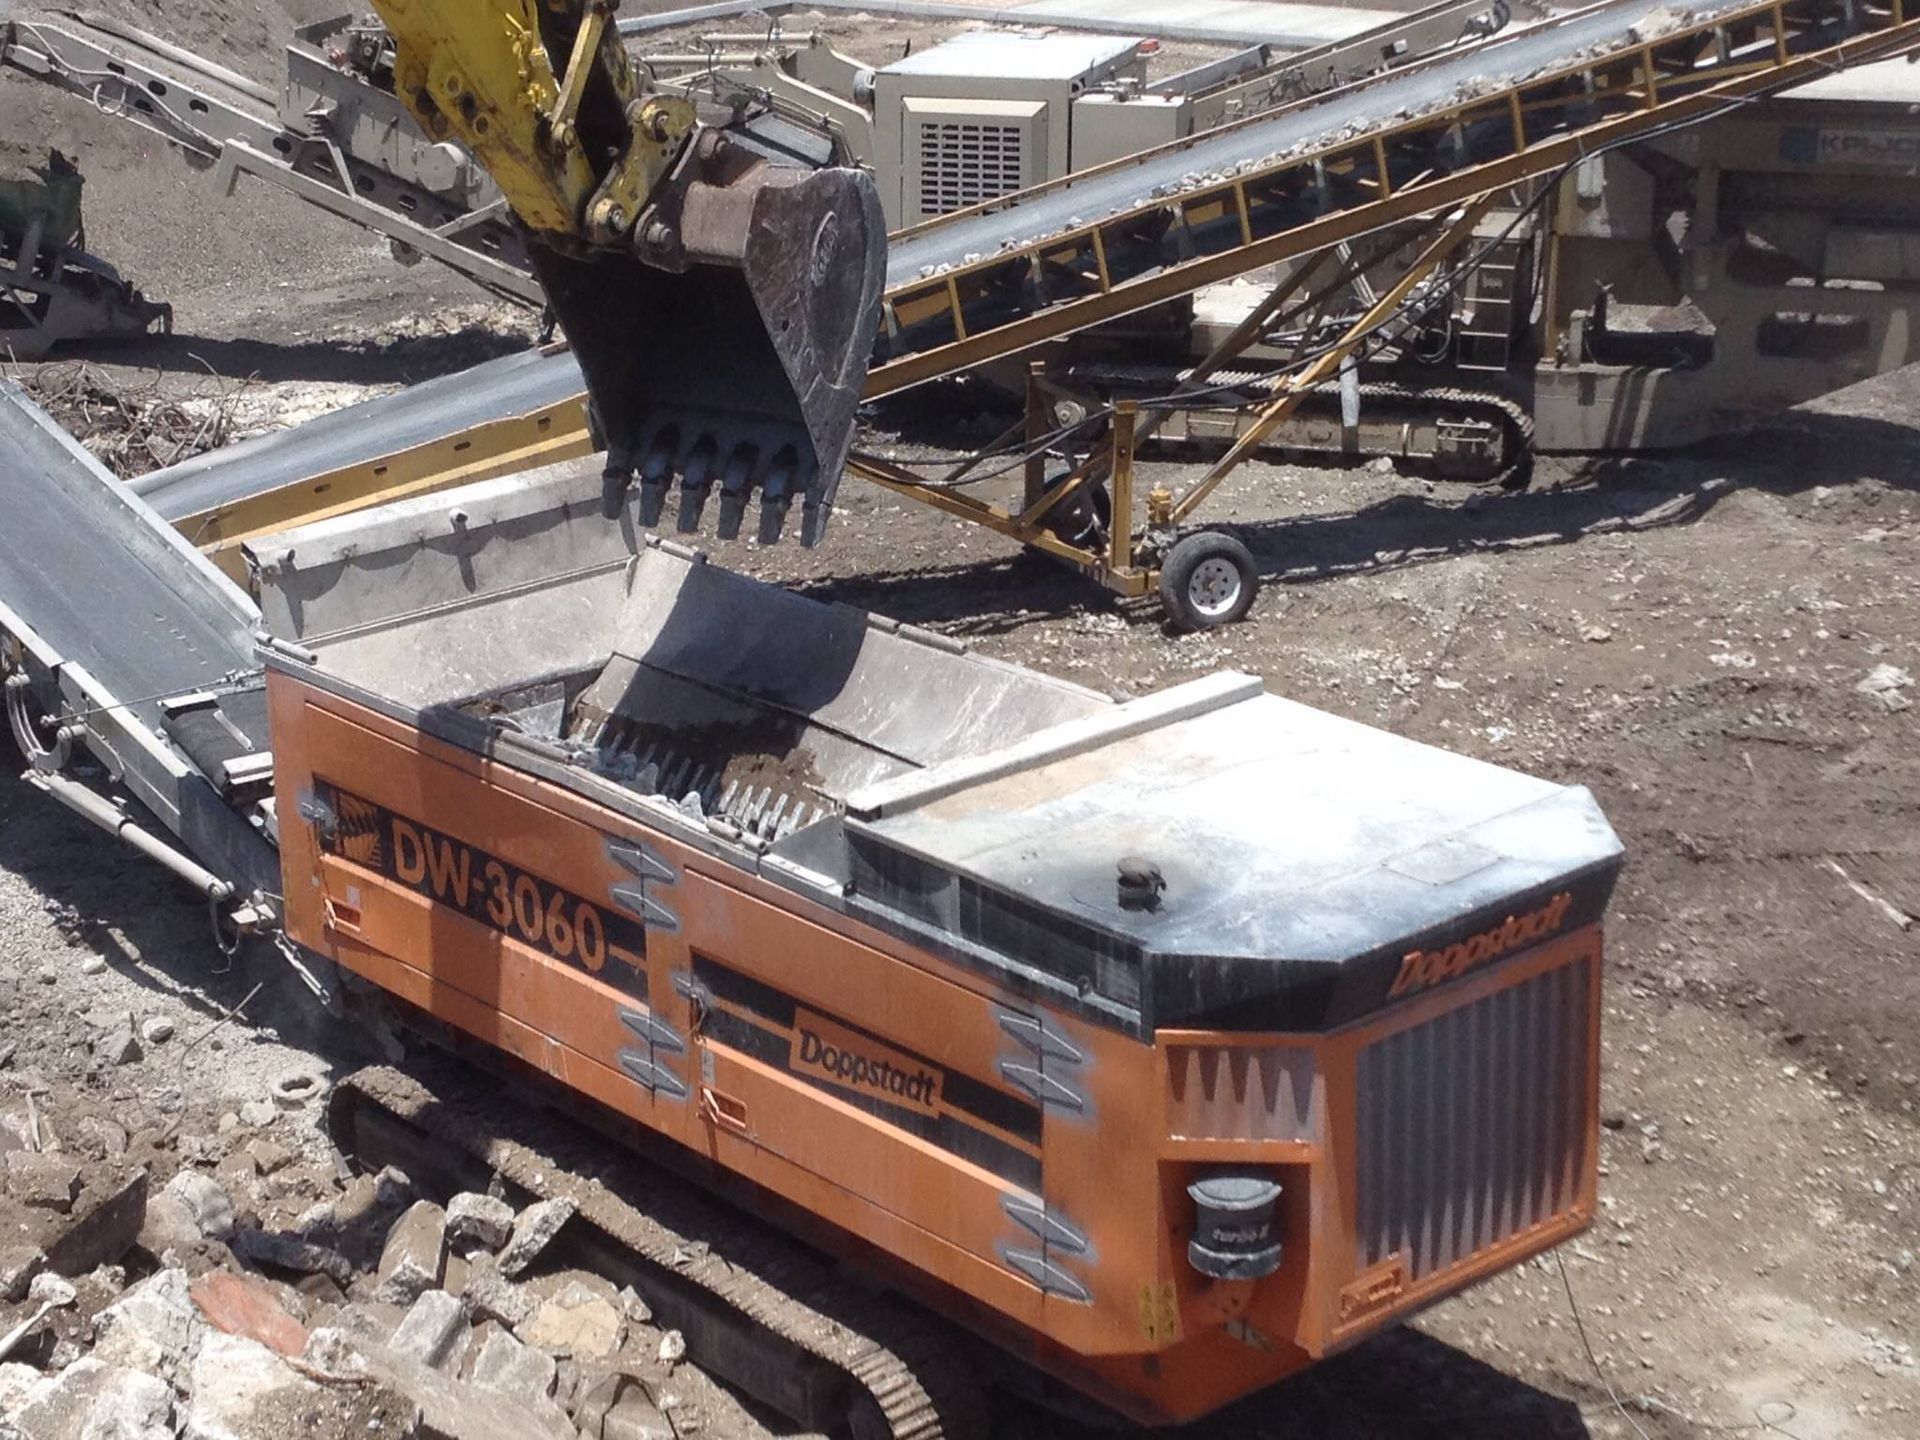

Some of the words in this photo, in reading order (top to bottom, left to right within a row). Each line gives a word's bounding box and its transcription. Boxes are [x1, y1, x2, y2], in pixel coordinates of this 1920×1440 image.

[391, 818, 605, 972] DW-3060
[1388, 891, 1573, 998] Doppstadt
[801, 1029, 936, 1106] Doppstadt
